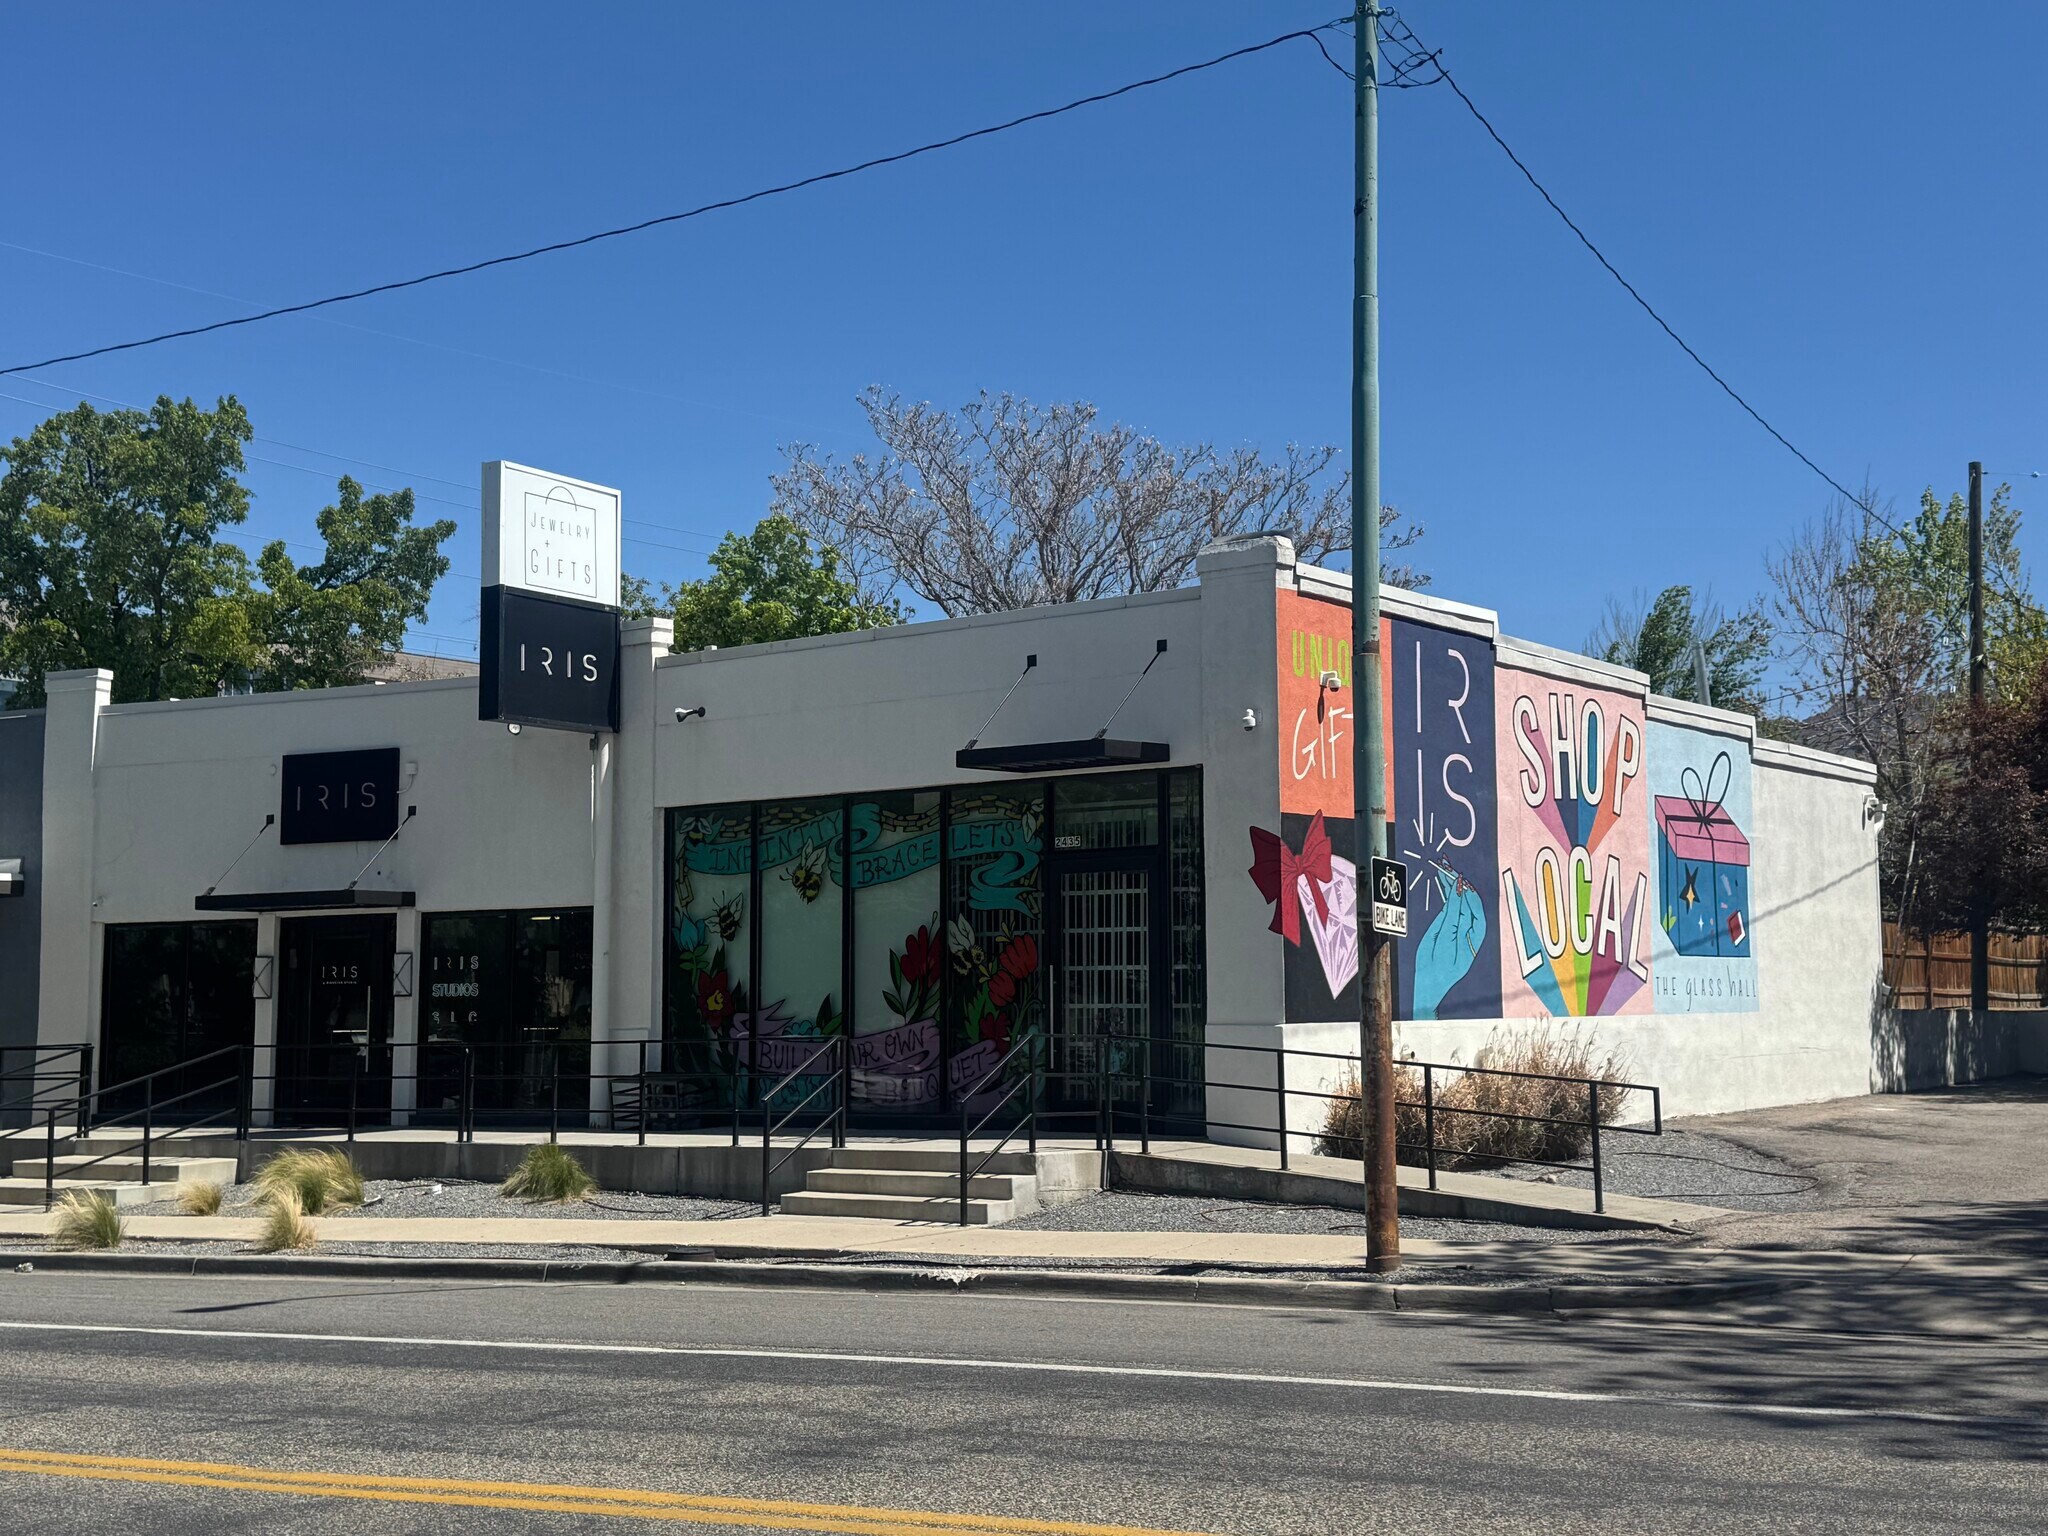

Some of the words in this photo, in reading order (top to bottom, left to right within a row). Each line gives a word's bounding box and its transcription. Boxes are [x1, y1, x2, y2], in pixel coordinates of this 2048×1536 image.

[530, 512, 590, 539] JEWELRY
[530, 549, 591, 584] GIFTS
[520, 643, 598, 682] IRIS
[1292, 629, 1351, 687] UNIQ
[1292, 706, 1388, 780] GIF
[1512, 692, 1641, 817] SHOP
[297, 782, 376, 811] IRIS
[1056, 837, 1080, 847] 2435
[1376, 906, 1390, 926] BIKE
[1390, 910, 1405, 928] LANE
[1502, 845, 1649, 983] LOCAL
[322, 966, 358, 978] IRIS
[433, 955, 479, 970] IRIS
[432, 983, 479, 997] STUDIOS
[1655, 976, 1676, 995] THE
[759, 1040, 814, 1070] BUILD
[823, 1041, 880, 1071] YUR
[885, 1026, 924, 1059] OWN
